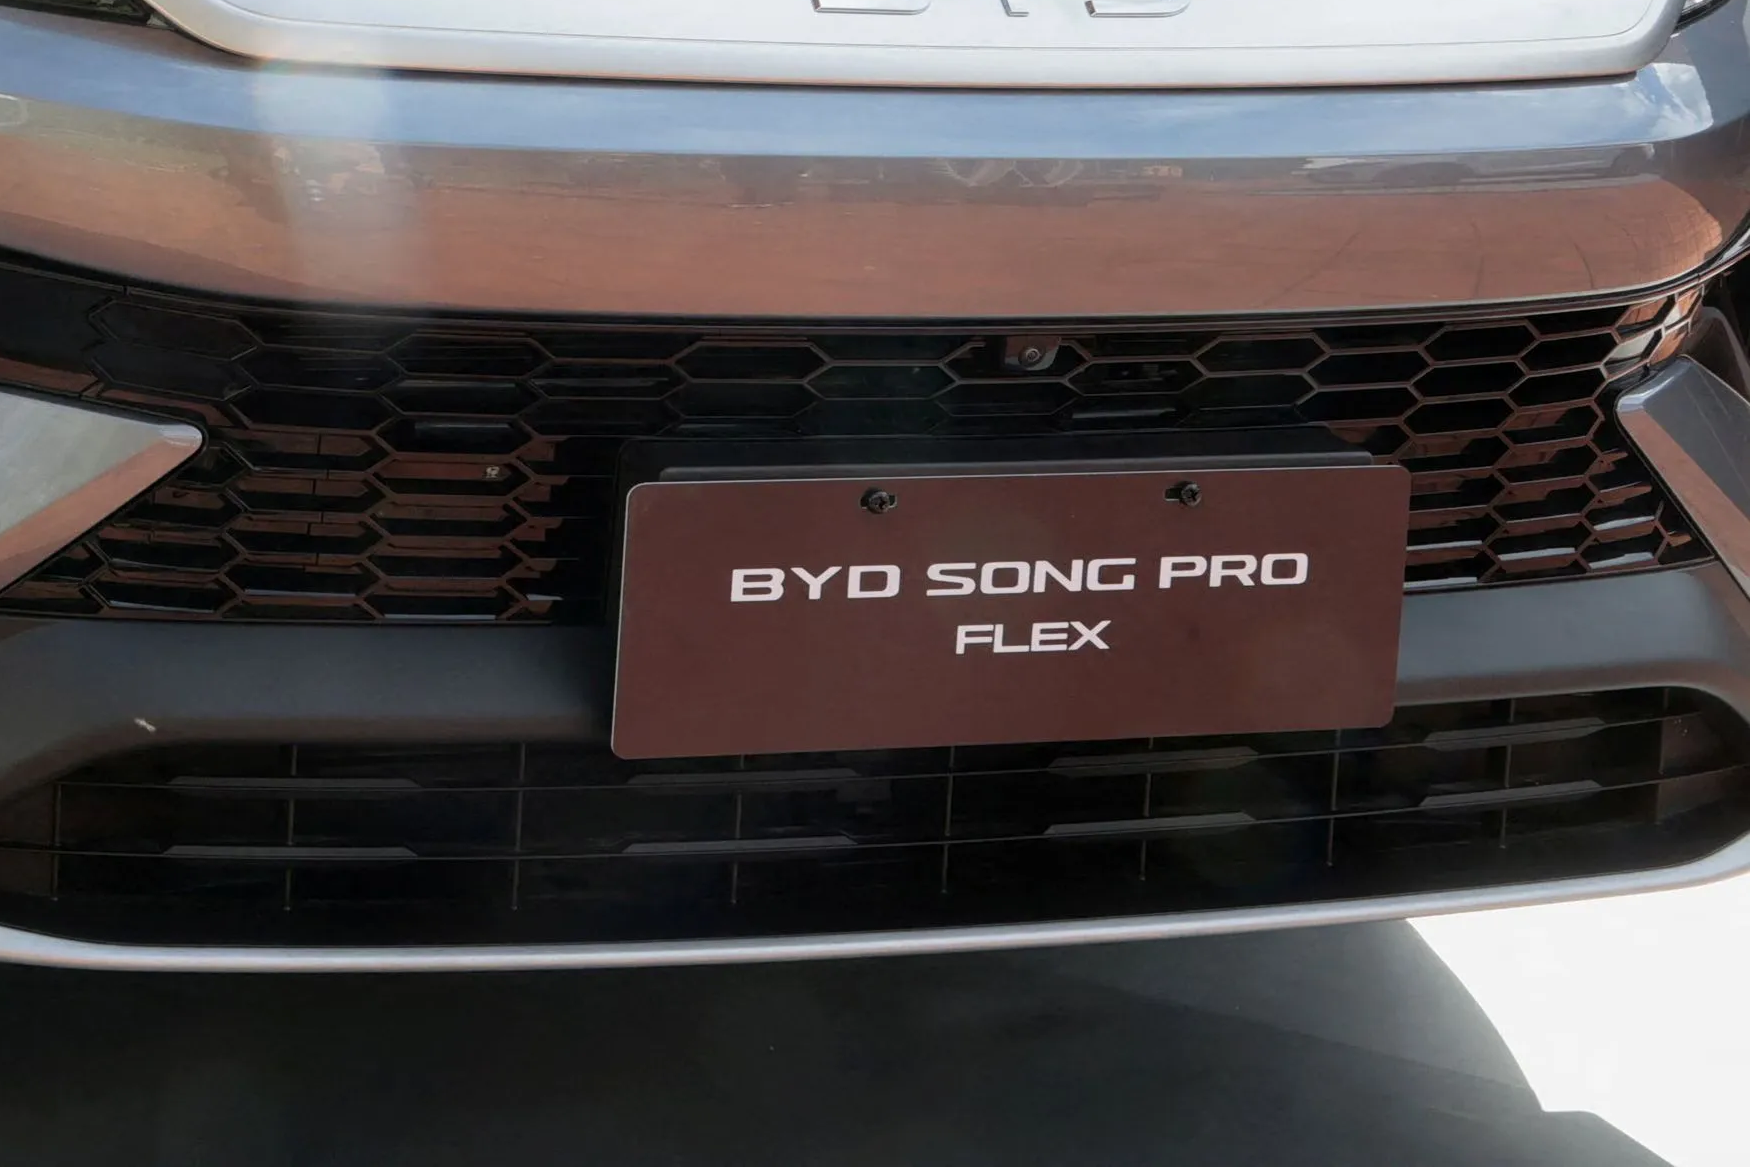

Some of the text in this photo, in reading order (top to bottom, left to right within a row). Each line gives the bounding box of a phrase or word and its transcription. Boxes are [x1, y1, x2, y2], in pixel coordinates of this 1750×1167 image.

[730, 552, 1309, 602] BYD SONG PRO
[955, 620, 1111, 655] FLEX
